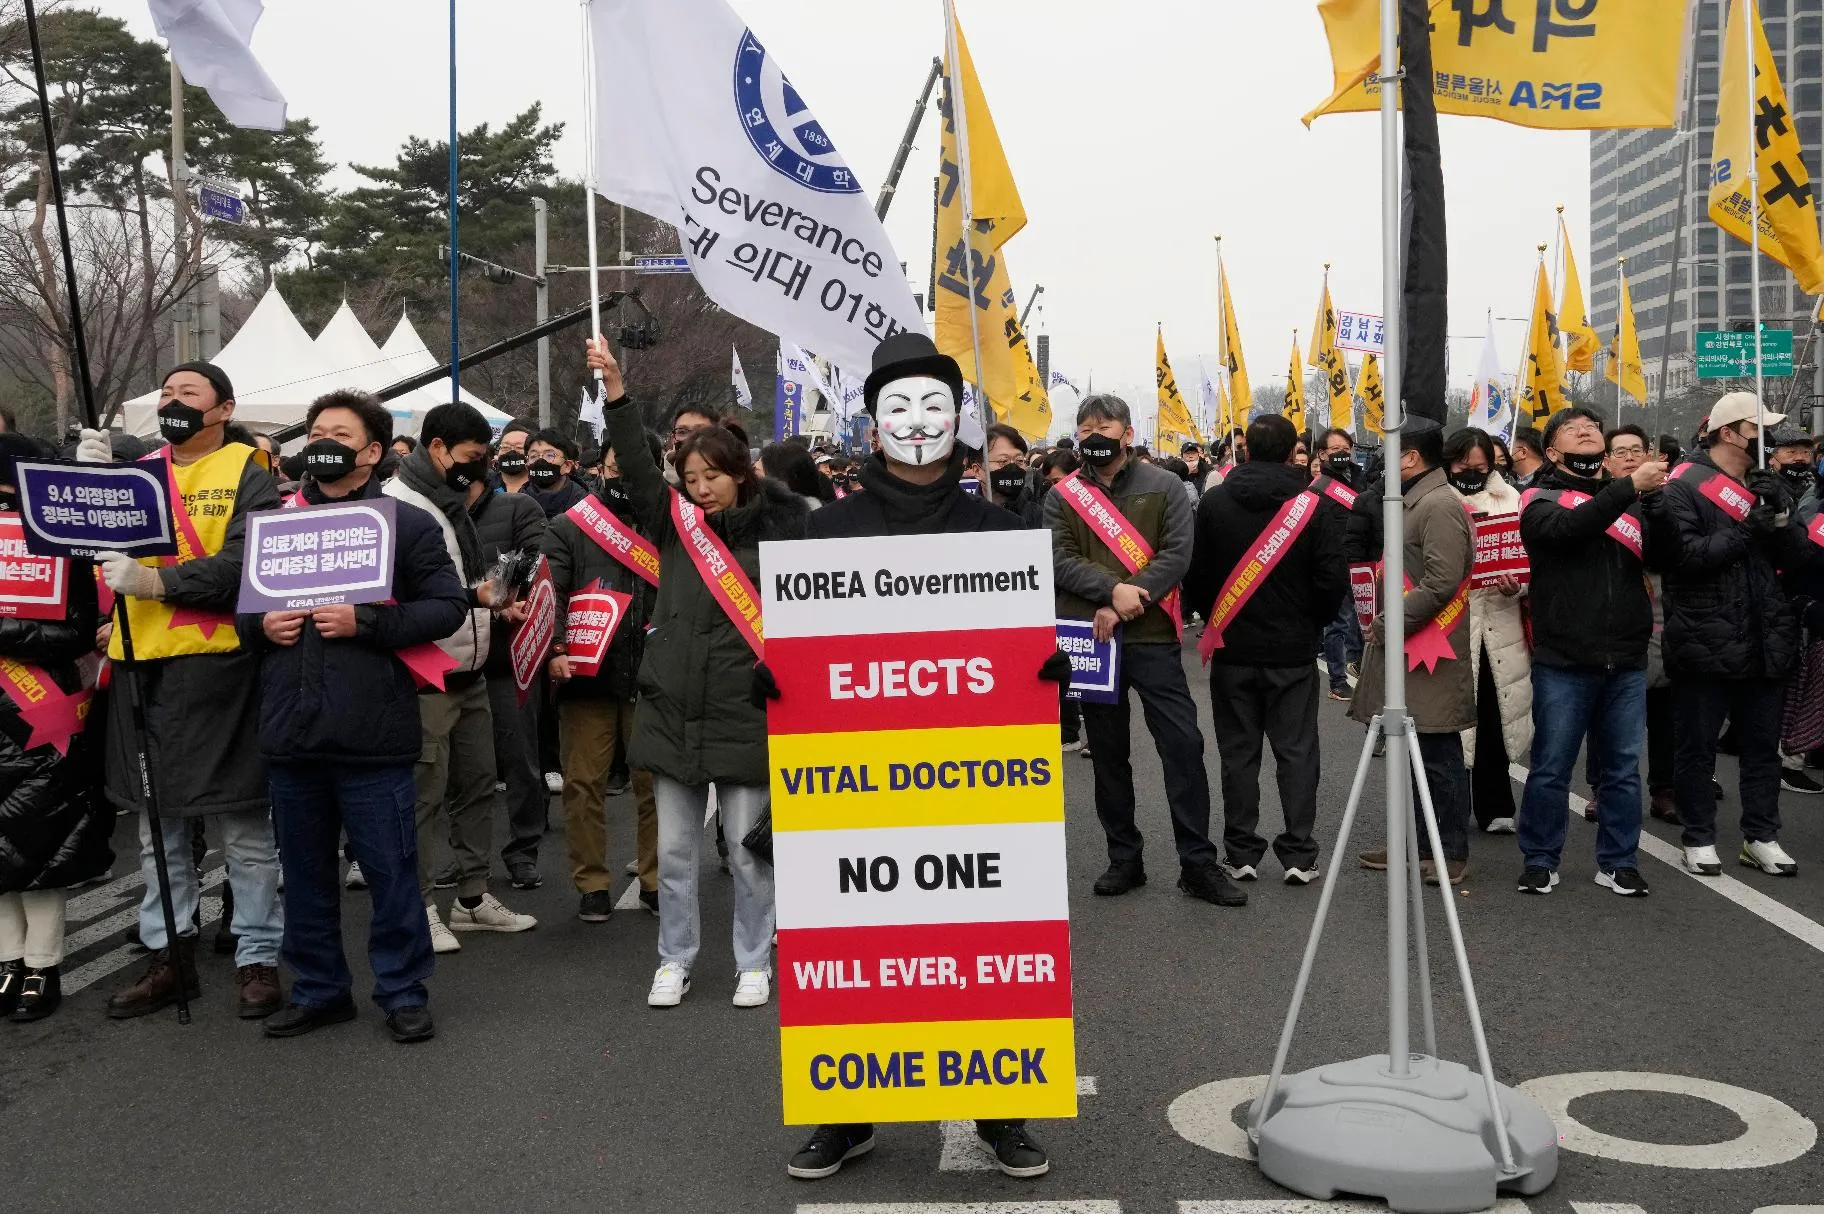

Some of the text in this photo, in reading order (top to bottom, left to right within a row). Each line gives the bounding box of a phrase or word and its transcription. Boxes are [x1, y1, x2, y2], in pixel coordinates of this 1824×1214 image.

[803, 129, 828, 147] 1885
[691, 166, 883, 277] Severance
[1724, 205, 1746, 222] MEDICAL
[726, 243, 812, 300] 의대
[1340, 328, 1384, 345] 의사회
[317, 455, 343, 463] 재검토
[47, 485, 135, 506] 9.4 의정합의
[203, 504, 227, 517] 함께
[42, 505, 148, 529] 정부는 이행하라
[1065, 477, 1149, 569] 일방적인 정책추진 국민건강
[262, 526, 378, 554] 의료계와 합의없는
[594, 518, 632, 553] 정책추진
[629, 545, 660, 577] 국민건
[1475, 549, 1499, 563] 학교육
[1477, 533, 1500, 548] 비안된
[260, 548, 376, 577] 의대증원 결사반대
[691, 527, 728, 577] 확대추진
[718, 571, 758, 621] 의료체계
[1213, 493, 1310, 628] 의대정원 확대추진 의료체계 붕괴된다
[775, 565, 1039, 601] KOREA Government
[829, 657, 994, 700] EJECTS
[780, 758, 1051, 795] VITAL DOCTORS
[839, 853, 1001, 893] NO ONE
[793, 954, 1055, 990] WILL EVER, EVER
[810, 1048, 1048, 1090] COME BACK
